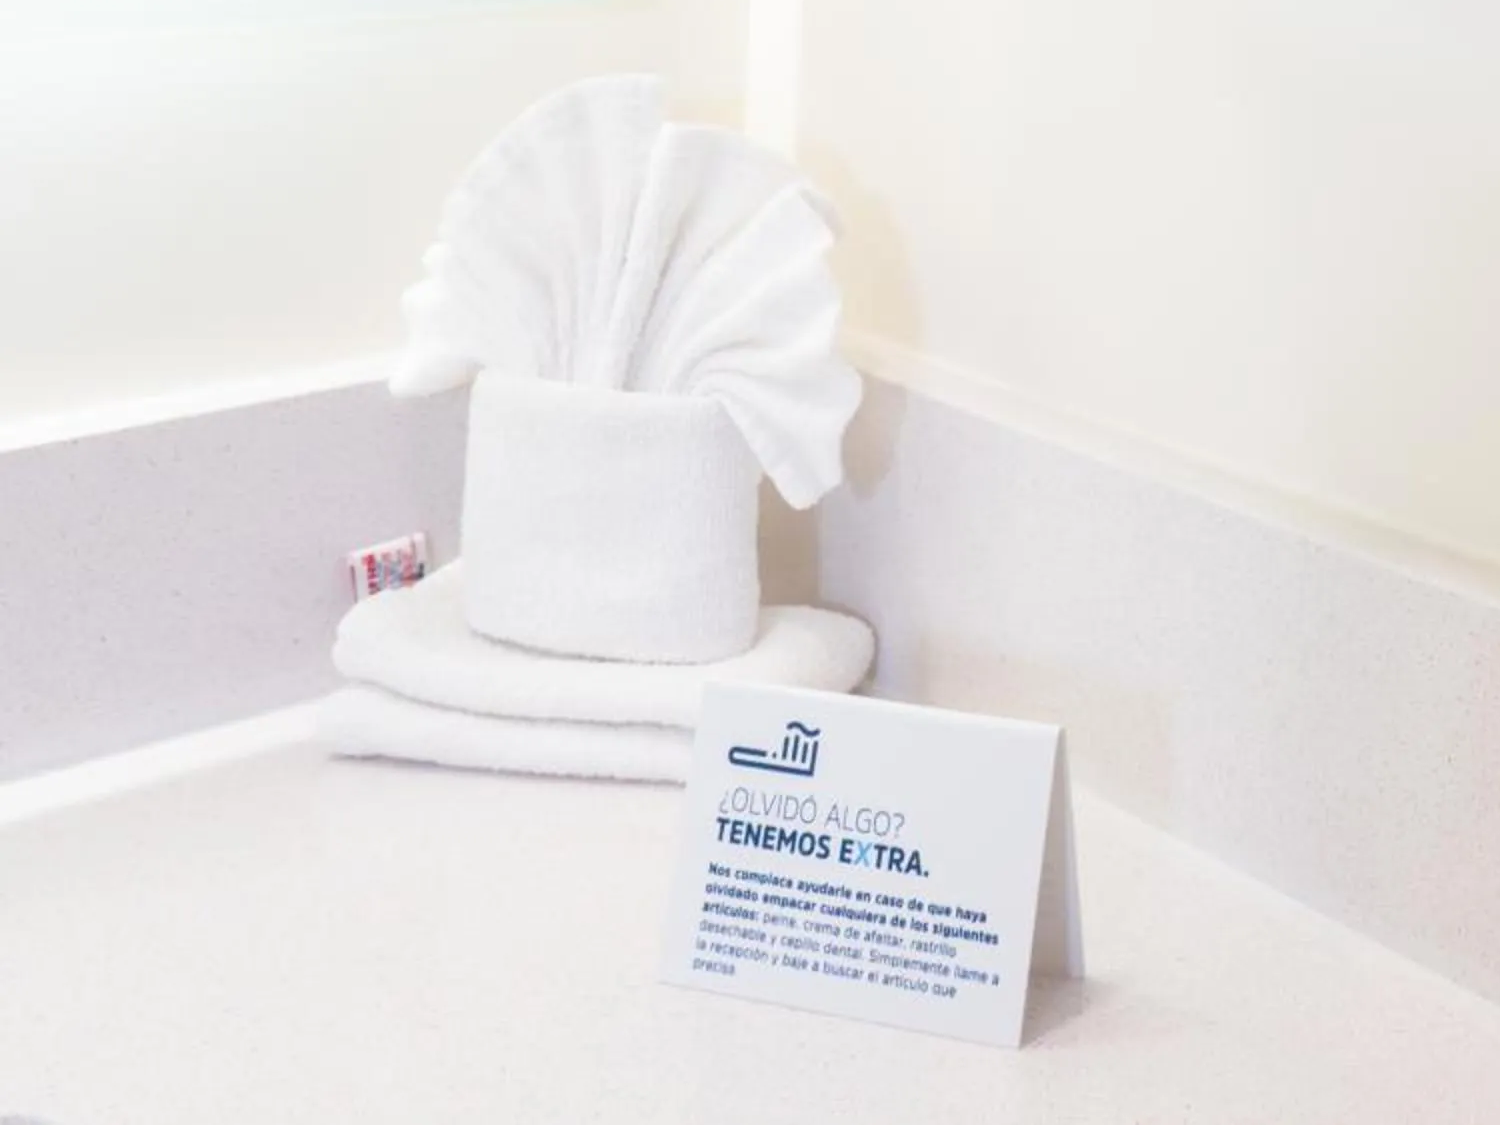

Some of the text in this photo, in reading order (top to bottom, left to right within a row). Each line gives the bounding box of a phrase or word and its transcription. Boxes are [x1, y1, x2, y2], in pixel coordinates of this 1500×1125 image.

[719, 785, 906, 839] ¿OLVIDÓ ALGO?
[716, 816, 930, 878] TENEMOS EXTRA.
[708, 861, 732, 878] Nos
[797, 879, 852, 899] ayudarle
[856, 890, 871, 903] en
[875, 893, 904, 908] caso
[907, 898, 924, 912] de
[928, 902, 952, 918] que
[955, 906, 987, 924] haya
[762, 892, 817, 911] empacar
[890, 915, 907, 929] de
[910, 916, 929, 933] los
[932, 923, 999, 946] siguientes
[843, 926, 861, 940] de
